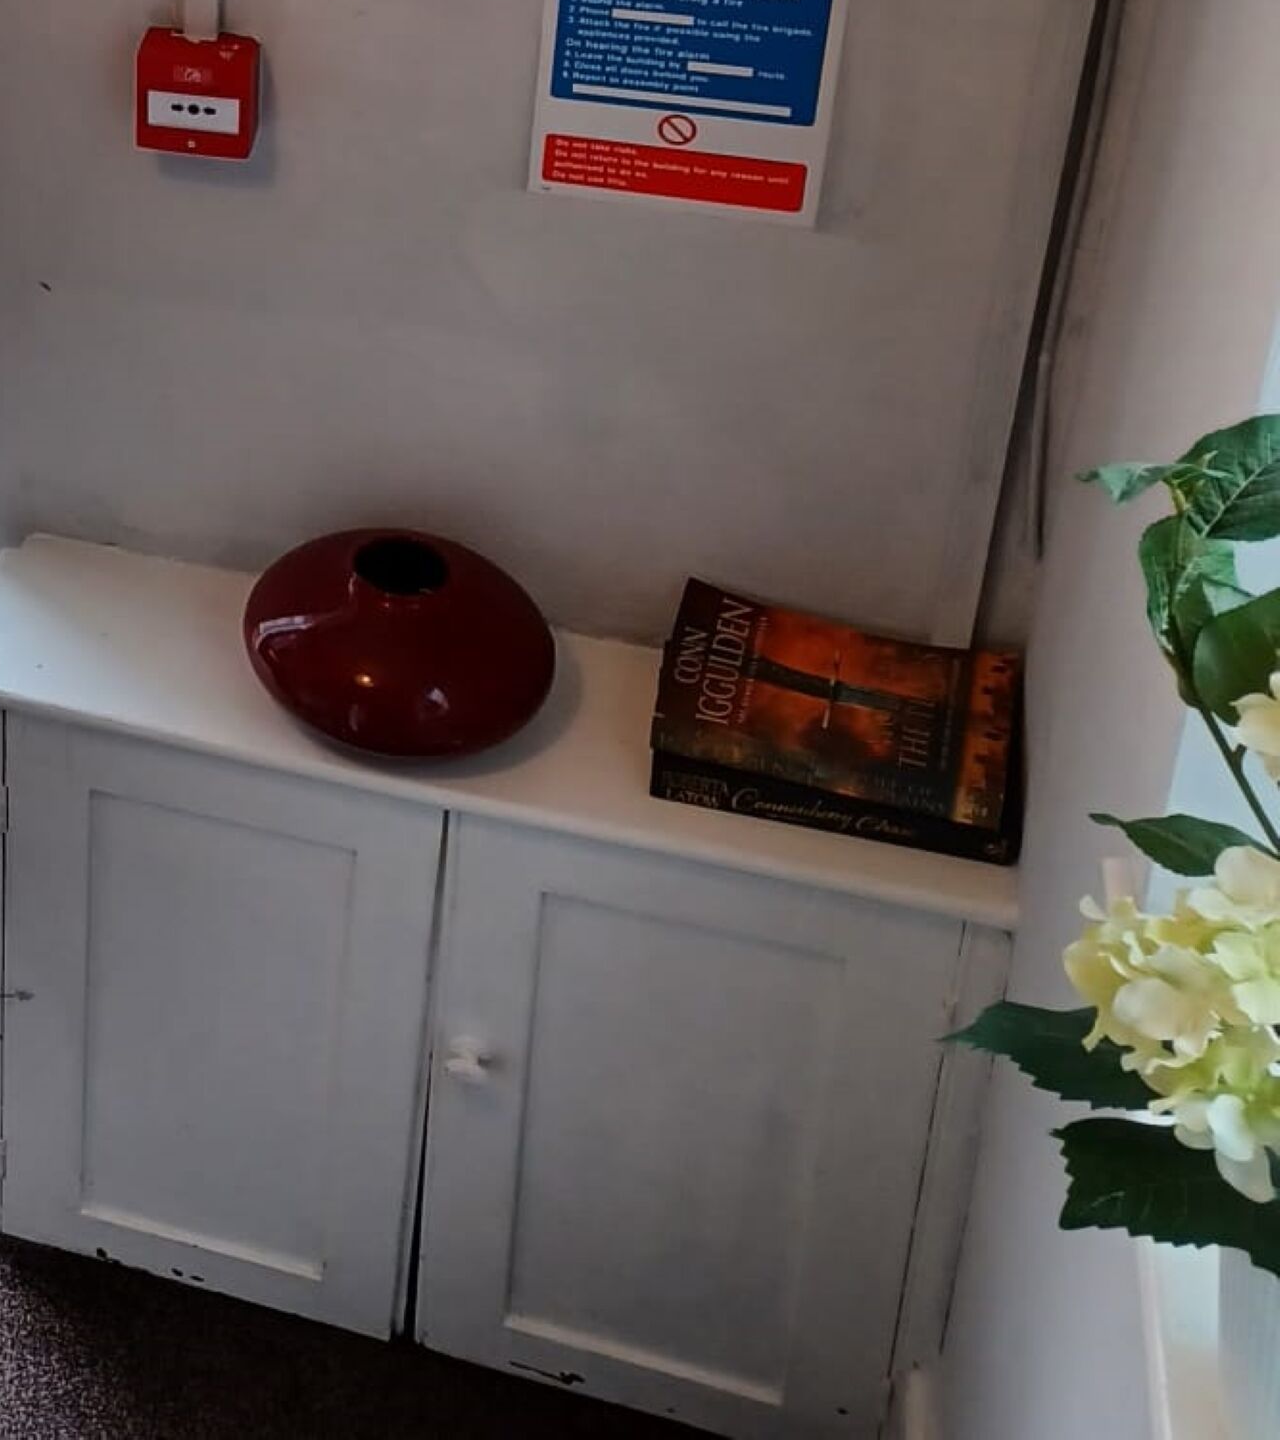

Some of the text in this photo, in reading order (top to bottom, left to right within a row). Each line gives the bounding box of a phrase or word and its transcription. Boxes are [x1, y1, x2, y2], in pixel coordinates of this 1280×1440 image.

[578, 6, 610, 16] Phone
[697, 18, 707, 26] to
[710, 19, 729, 28] call
[731, 21, 749, 29] the
[751, 23, 769, 32] fire
[578, 17, 611, 27] Attack
[614, 20, 630, 29] the
[634, 23, 650, 31] fire
[666, 26, 709, 37] possible
[712, 32, 740, 42] using
[744, 34, 761, 43] the
[565, 38, 581, 47] On
[585, 40, 628, 55] hearing
[632, 45, 651, 54] the
[655, 47, 674, 57] fire
[574, 51, 603, 60] Leave
[607, 54, 623, 62] the
[626, 56, 666, 68] building
[669, 61, 681, 69] by
[574, 61, 602, 71] Close
[605, 64, 618, 72] all
[621, 66, 649, 76] doors
[652, 70, 687, 80] behind
[572, 71, 606, 82] Report
[622, 77, 669, 91] assembly
[671, 82, 699, 93] point
[555, 139, 570, 147] Do
[554, 149, 568, 158] Do
[590, 154, 618, 164] return
[730, 172, 765, 182] reason
[673, 625, 709, 684] CONN
[695, 596, 755, 726] IGGULDEN
